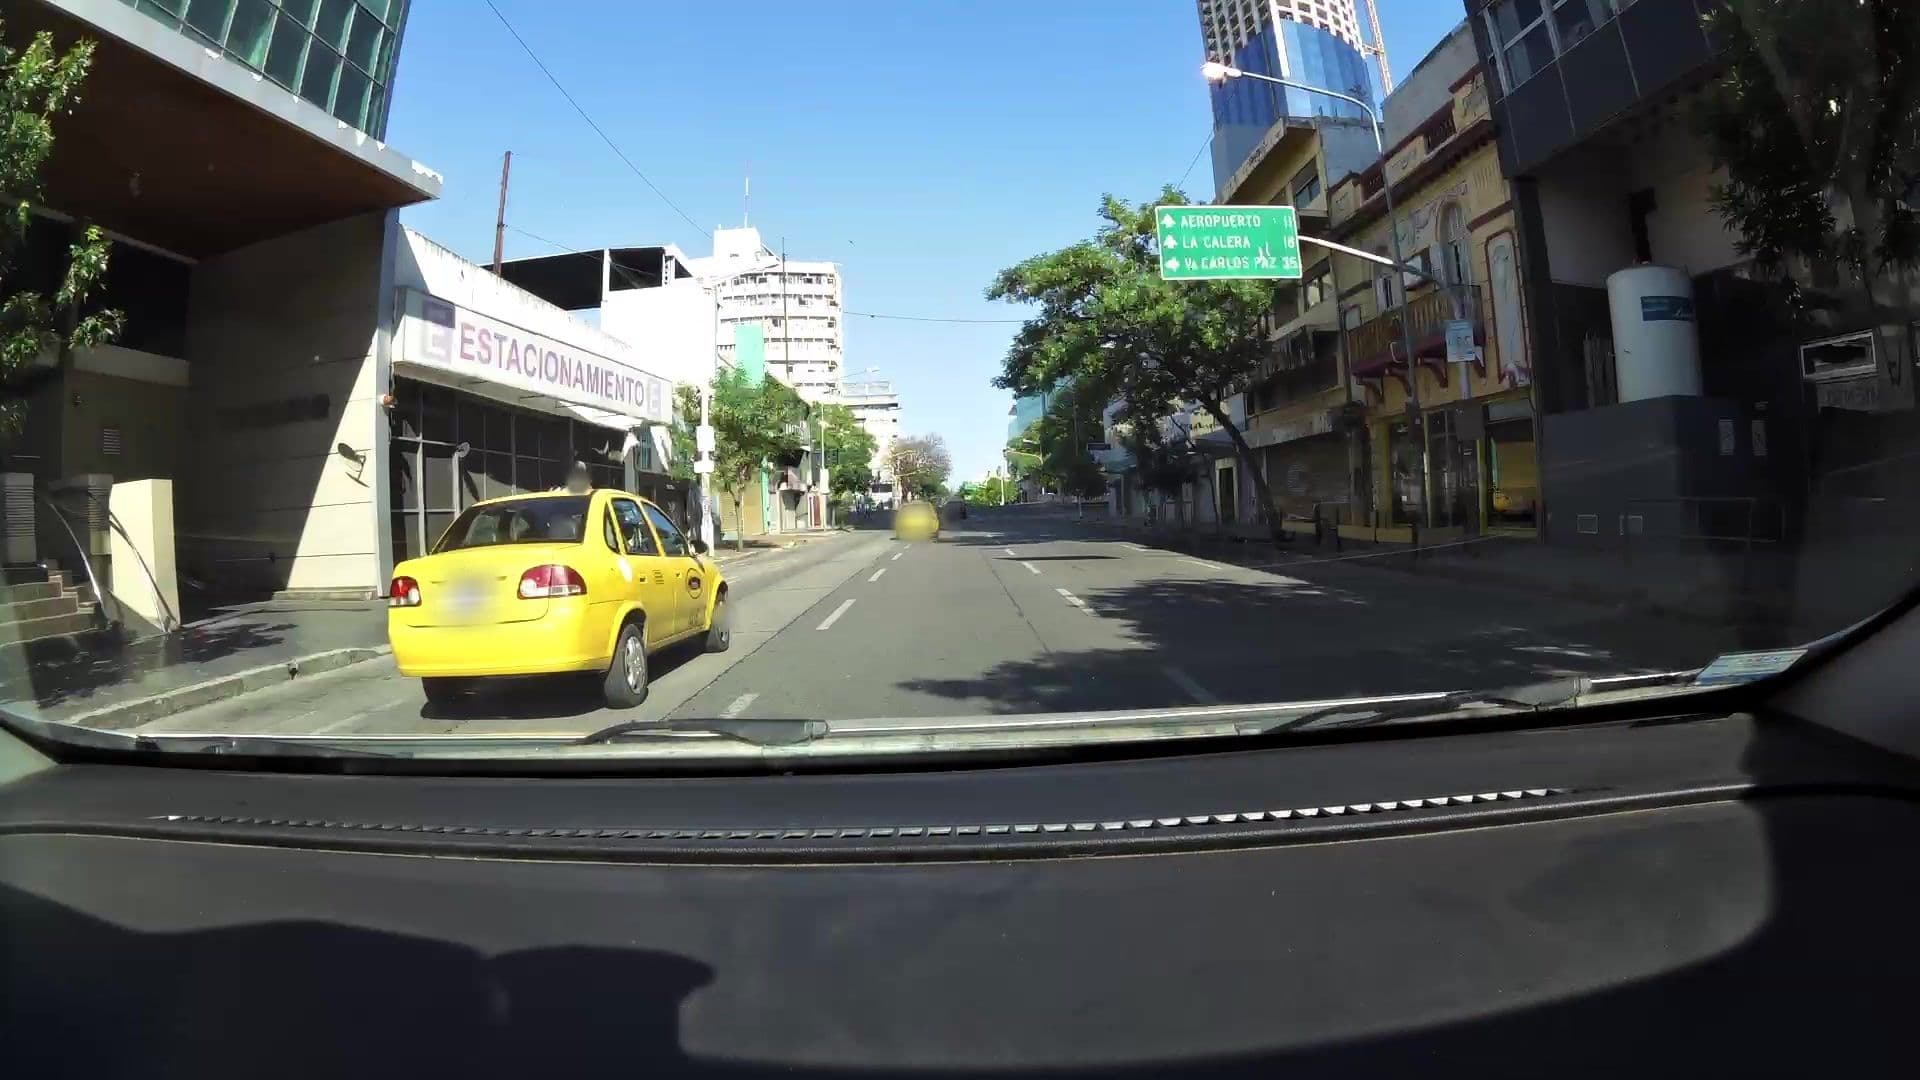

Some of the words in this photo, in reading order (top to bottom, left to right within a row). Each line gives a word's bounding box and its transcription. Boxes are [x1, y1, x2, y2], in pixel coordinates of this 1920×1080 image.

[1180, 214, 1261, 229] AEROPUERTO
[1182, 235, 1199, 248] LA
[1203, 235, 1251, 248] CALERA
[1201, 256, 1249, 270] CARLOS
[1254, 256, 1277, 270] PAZ
[1282, 256, 1298, 270] 35
[460, 322, 645, 408] ESTACIONAMIENTO
